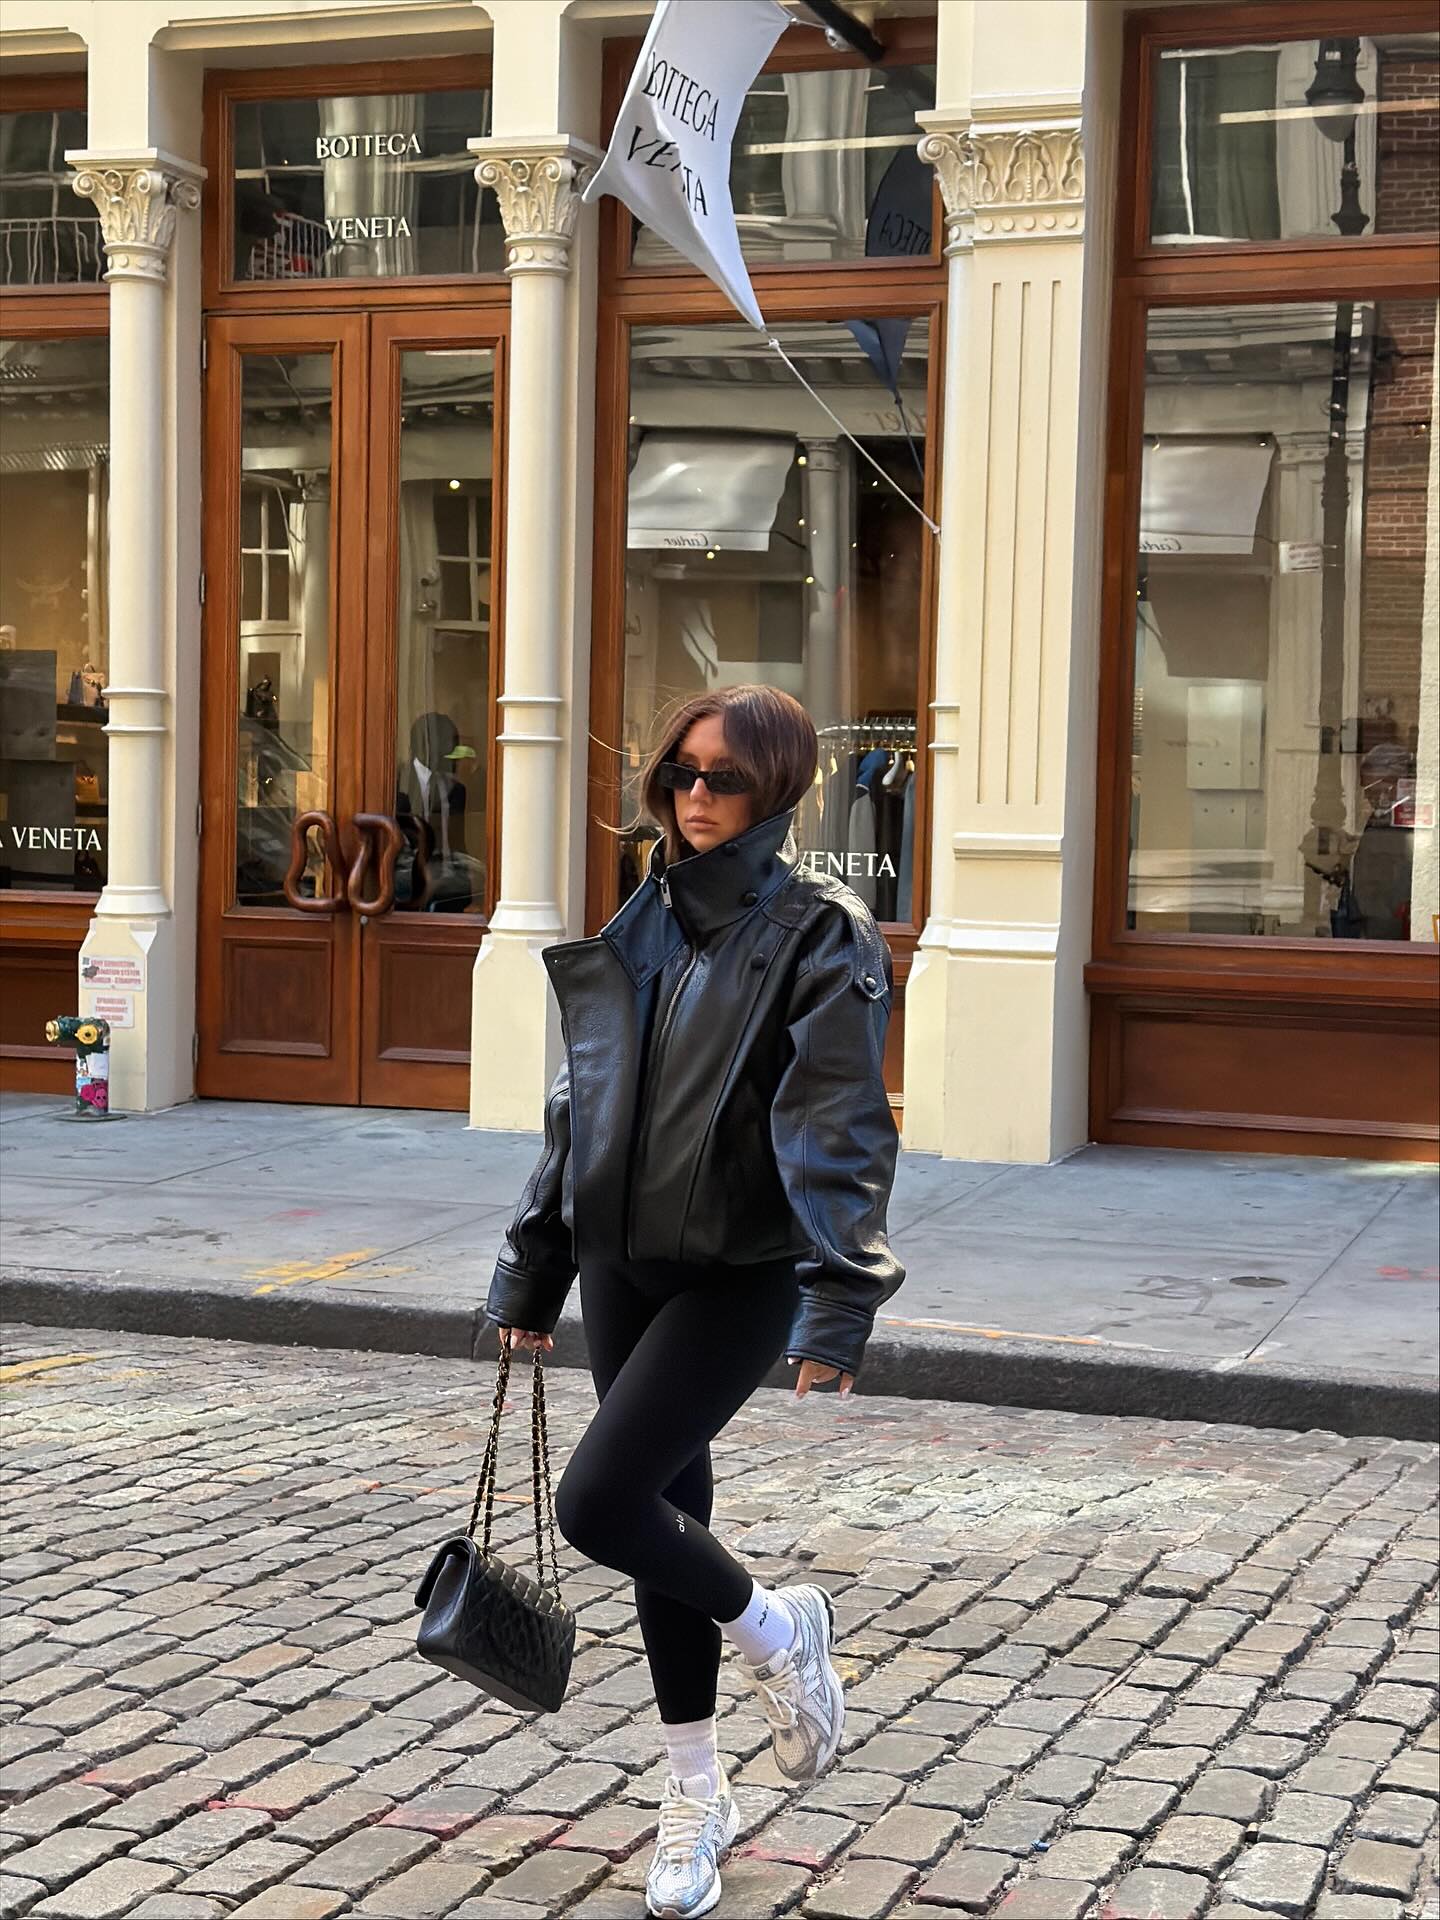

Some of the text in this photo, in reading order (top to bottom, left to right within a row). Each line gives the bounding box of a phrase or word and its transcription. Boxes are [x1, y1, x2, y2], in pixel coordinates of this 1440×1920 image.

[316, 133, 422, 159] BOTTEGA
[326, 216, 411, 240] VENETA
[11, 826, 102, 851] VENETA
[676, 1514, 685, 1533] alo
